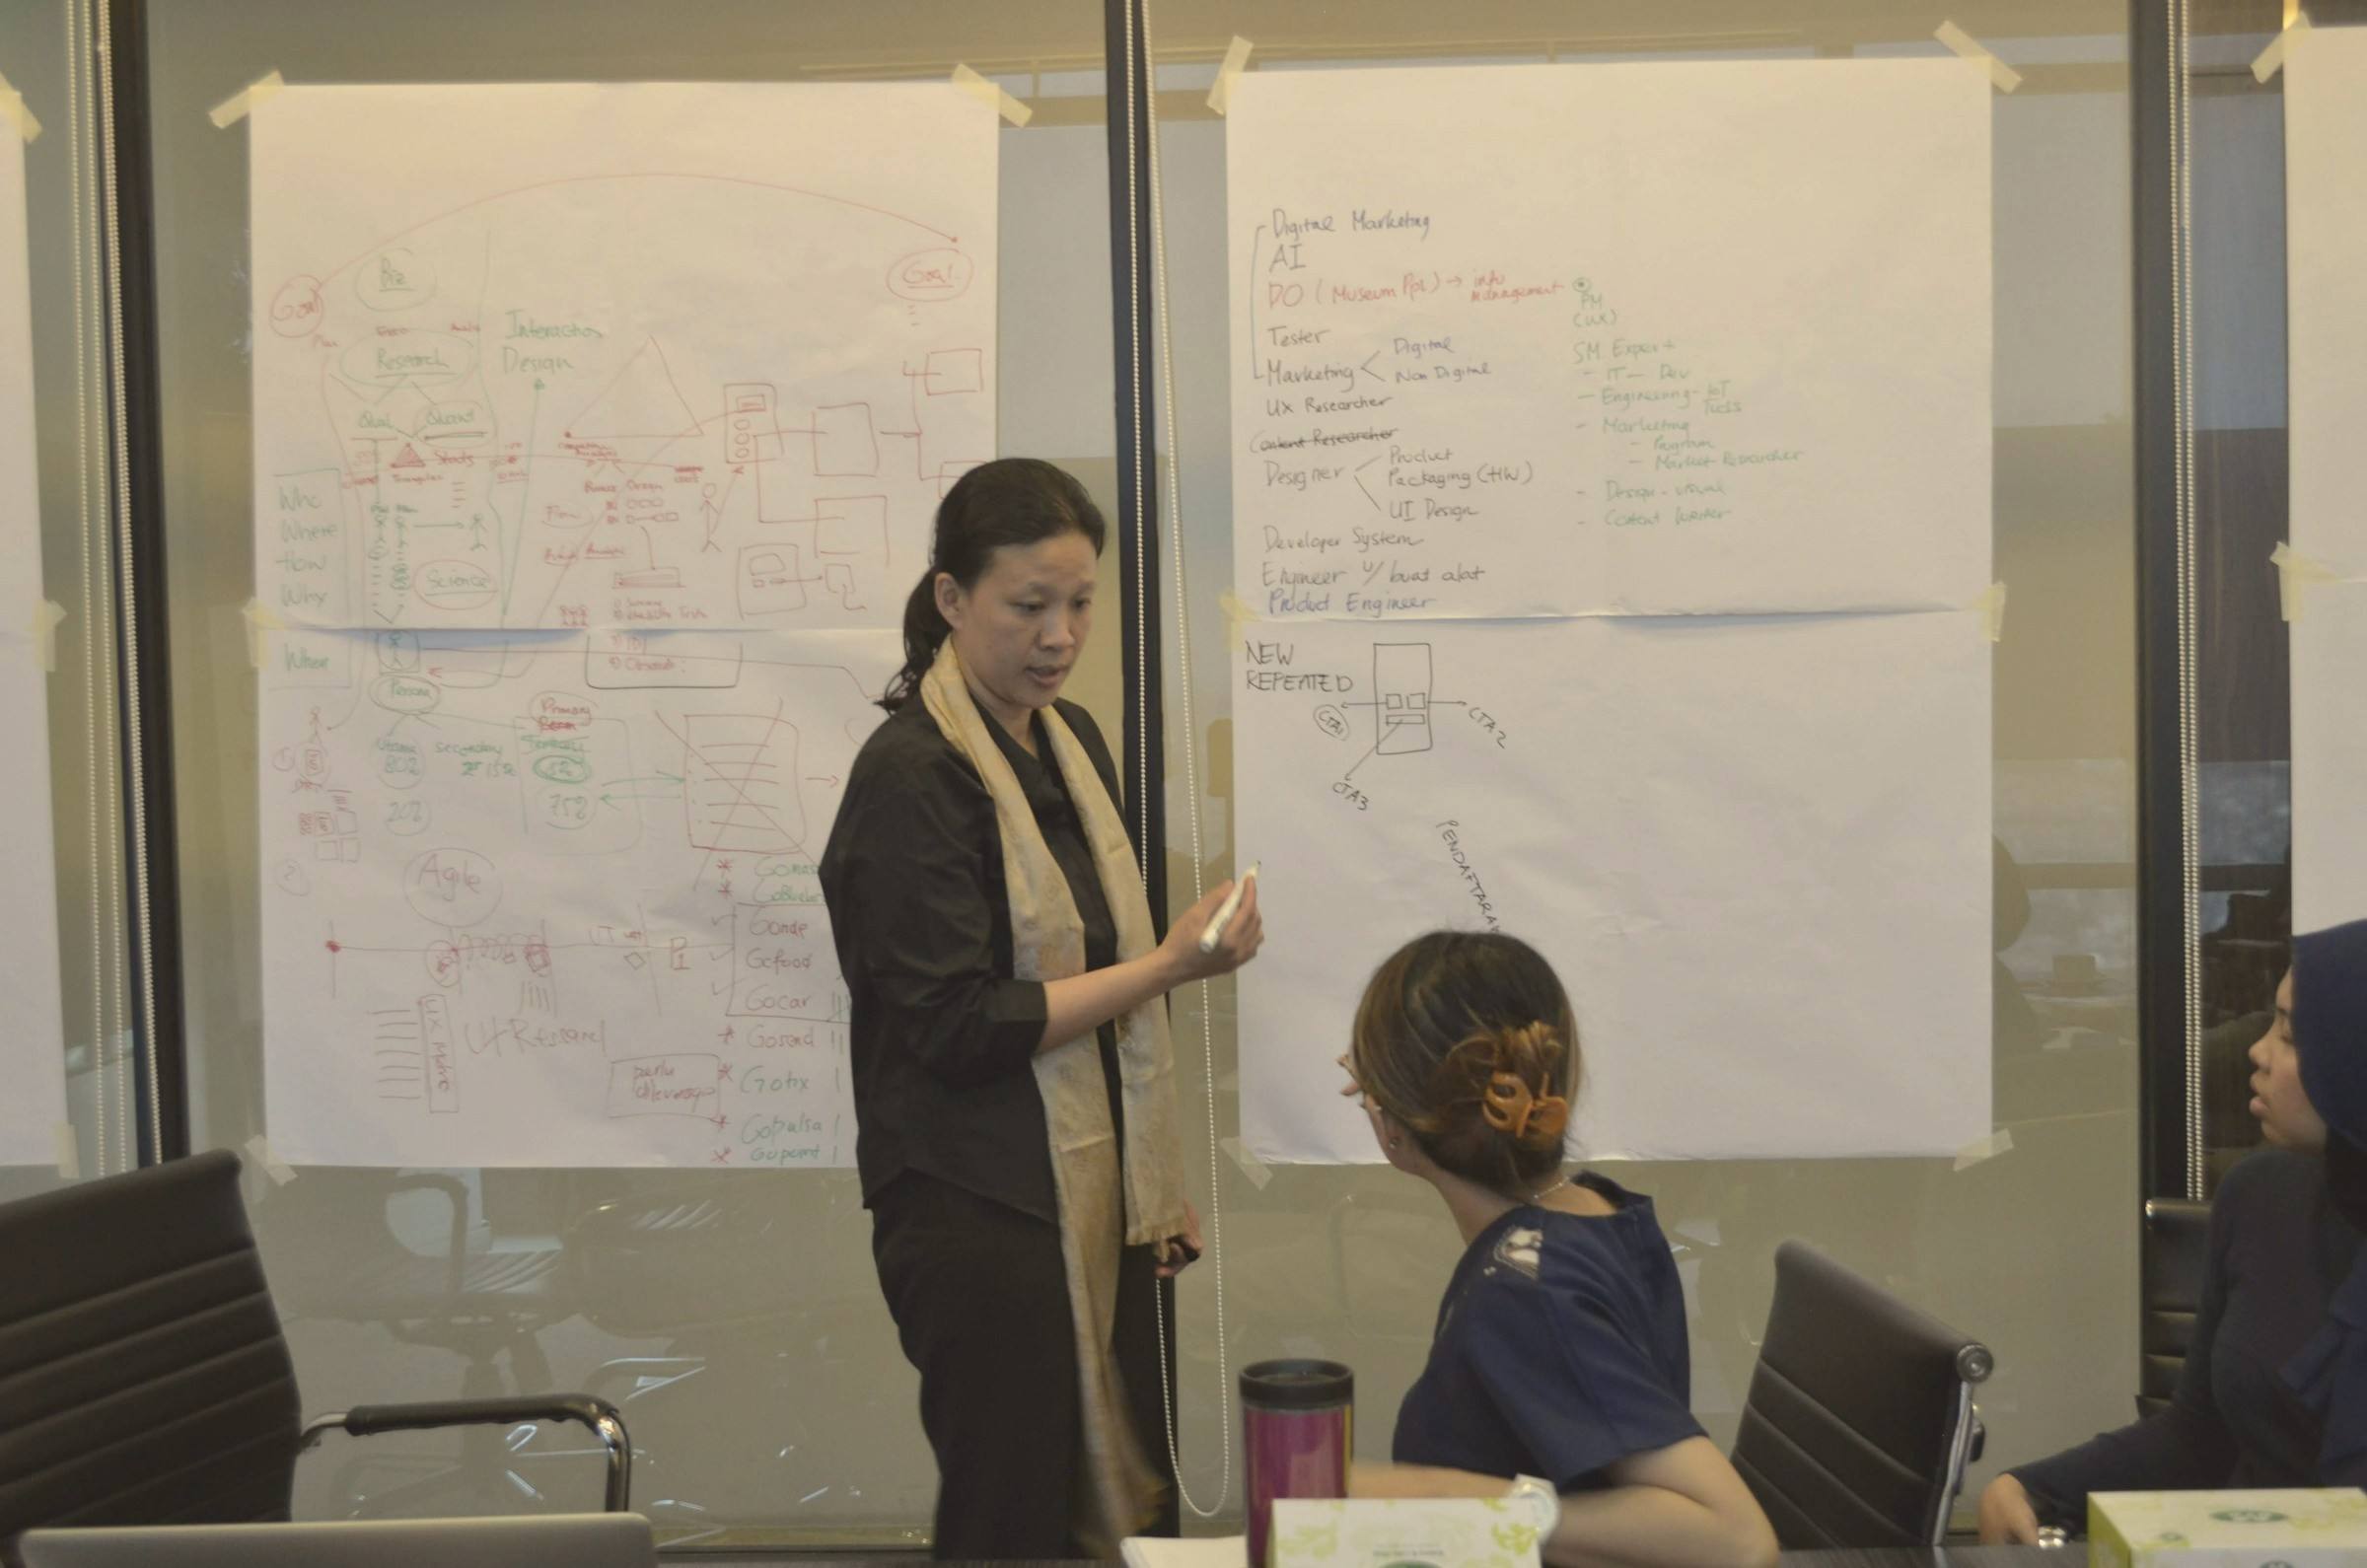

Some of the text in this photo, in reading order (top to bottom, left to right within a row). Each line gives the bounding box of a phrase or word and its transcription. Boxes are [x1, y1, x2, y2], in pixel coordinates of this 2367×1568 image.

[1272, 207, 1431, 242] Digital Marketing
[1268, 244, 1307, 273] AI
[1268, 281, 1304, 310] DO
[1266, 324, 1331, 347] Tester
[1393, 335, 1457, 359] Digital
[501, 345, 575, 374] Design
[1266, 358, 1355, 394] Marketing
[1395, 362, 1492, 385] Non Digital
[1266, 395, 1395, 418] UX Researcher
[1263, 459, 1346, 492] Designer
[1425, 497, 1480, 523] Design
[1246, 640, 1294, 667] NEW
[1246, 670, 1355, 693] REPEATED
